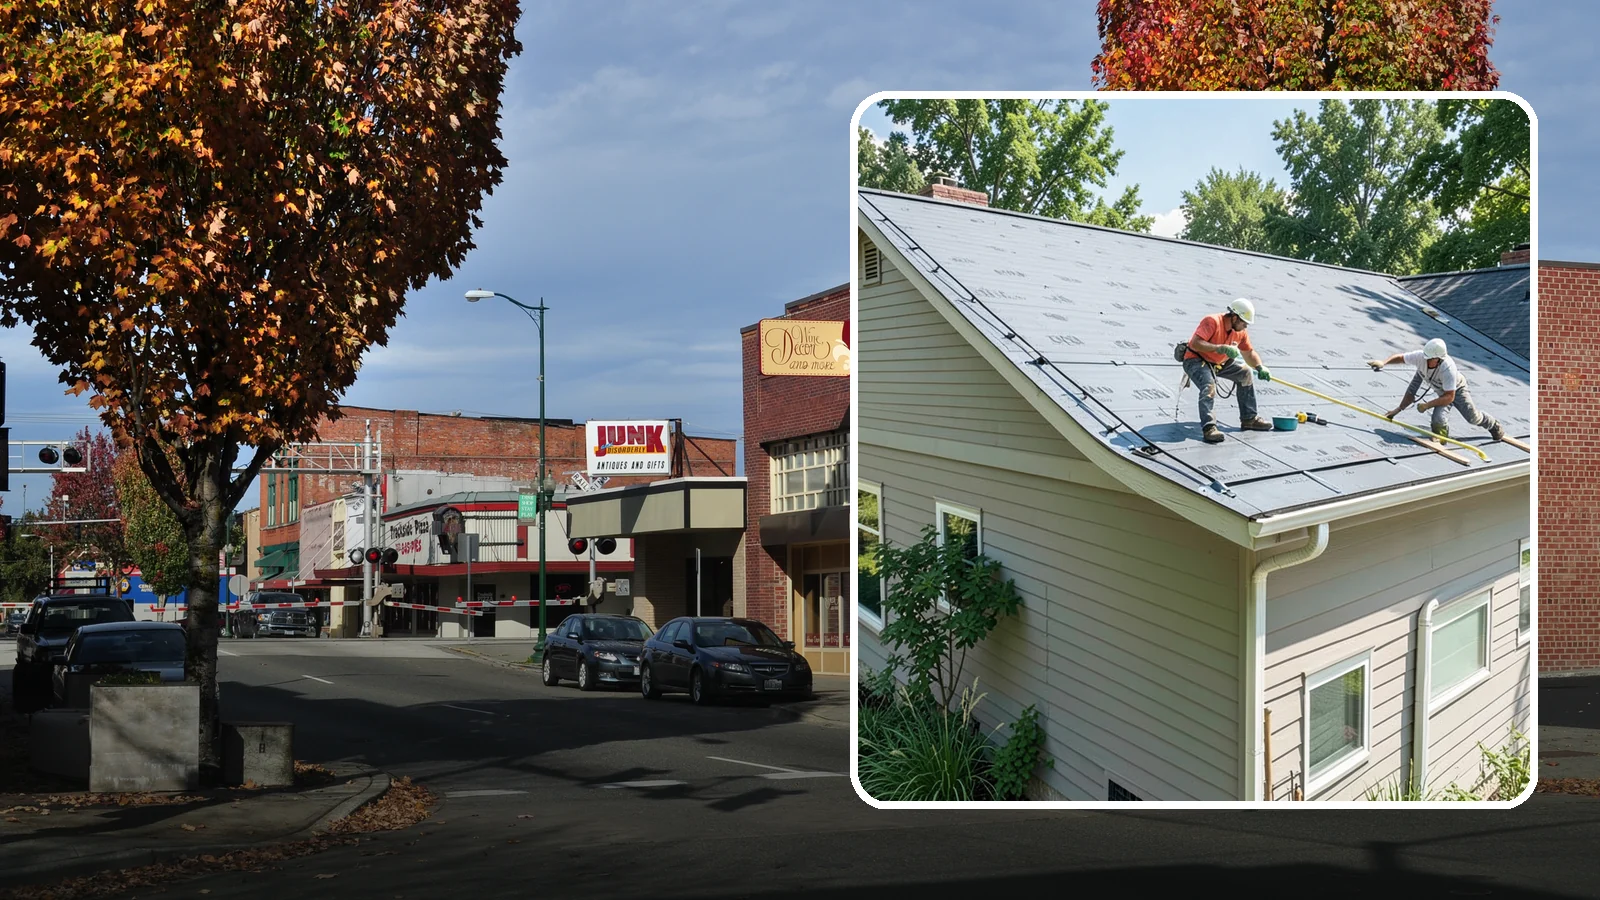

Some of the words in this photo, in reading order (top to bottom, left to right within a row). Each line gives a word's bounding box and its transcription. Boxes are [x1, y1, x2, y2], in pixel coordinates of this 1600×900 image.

[595, 425, 665, 458] JUNK
[607, 446, 646, 454] DISORDERLY
[596, 461, 628, 470] ANTIQUES
[631, 460, 644, 470] AND
[647, 460, 665, 470] GIFTS
[590, 475, 609, 491] SING
[352, 498, 365, 511] CRO
[390, 521, 413, 540] Trackside
[414, 519, 430, 535] Pizza
